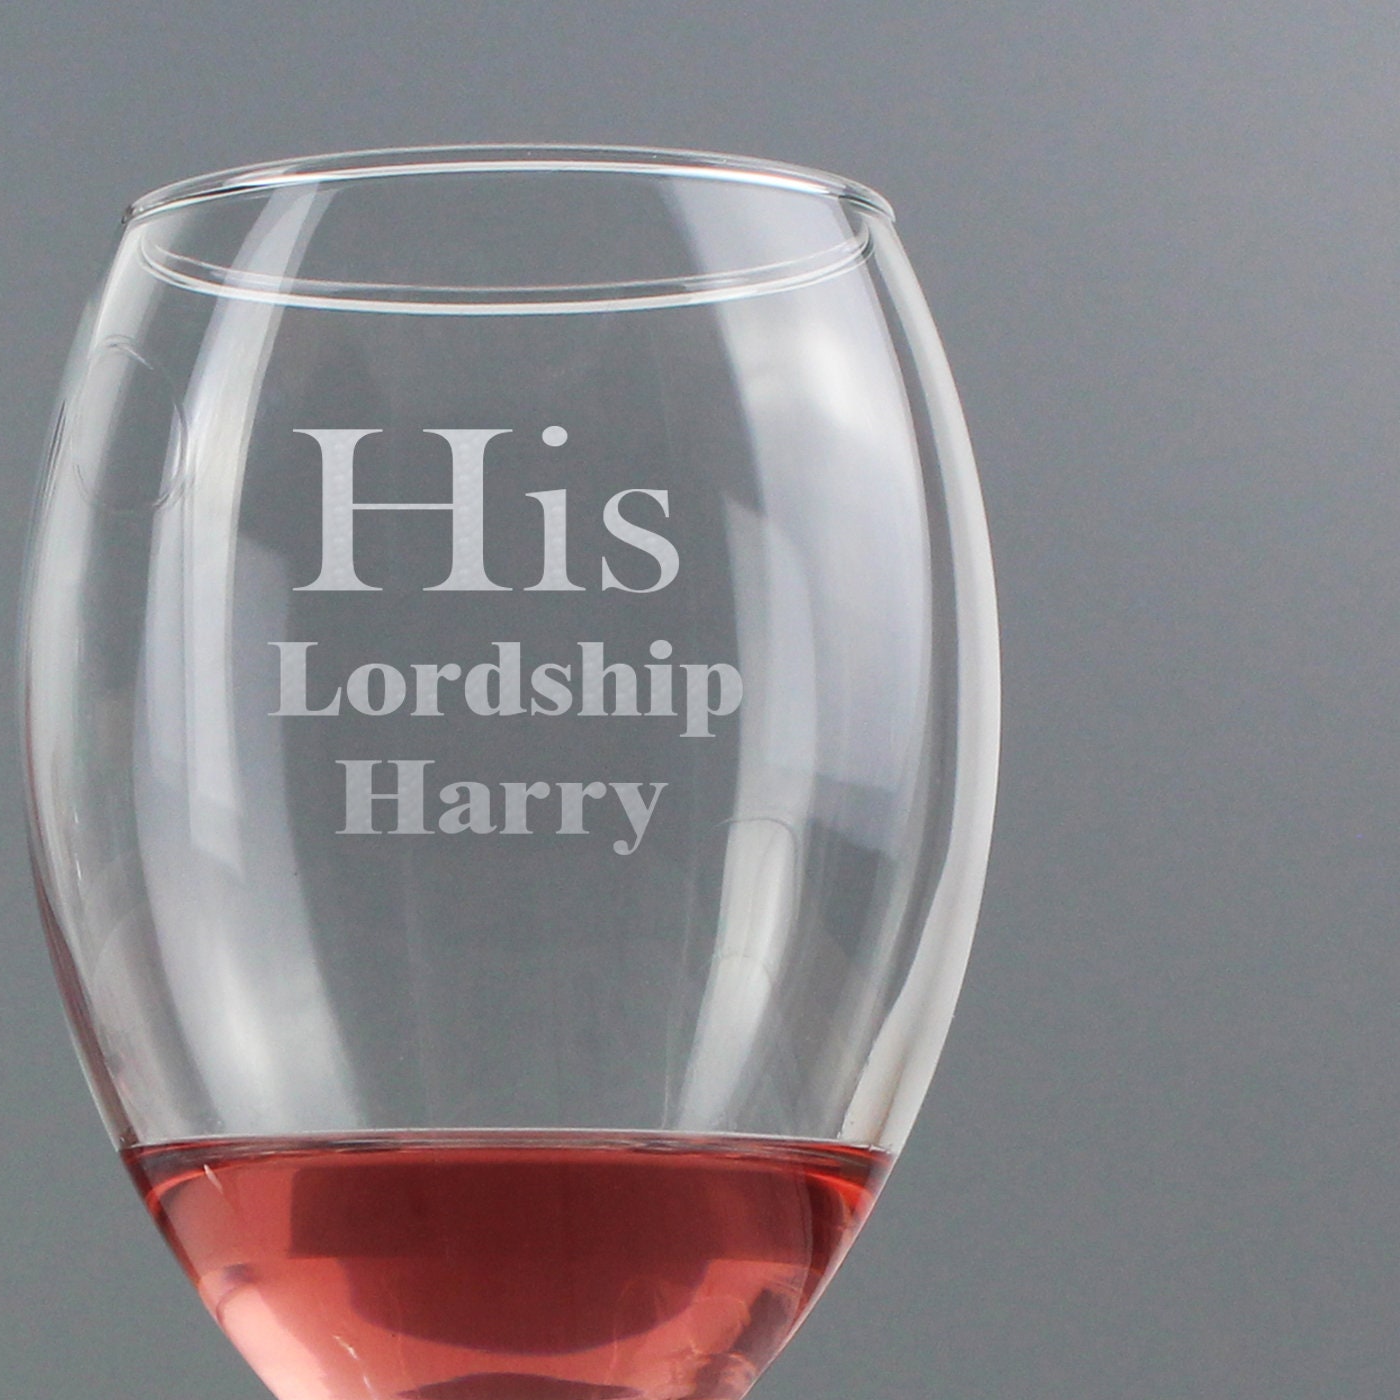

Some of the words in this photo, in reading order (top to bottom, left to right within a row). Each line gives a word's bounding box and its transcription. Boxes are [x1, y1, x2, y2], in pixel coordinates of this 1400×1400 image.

[292, 425, 680, 594] His
[267, 639, 744, 738] Lordship
[334, 759, 670, 856] Harry
